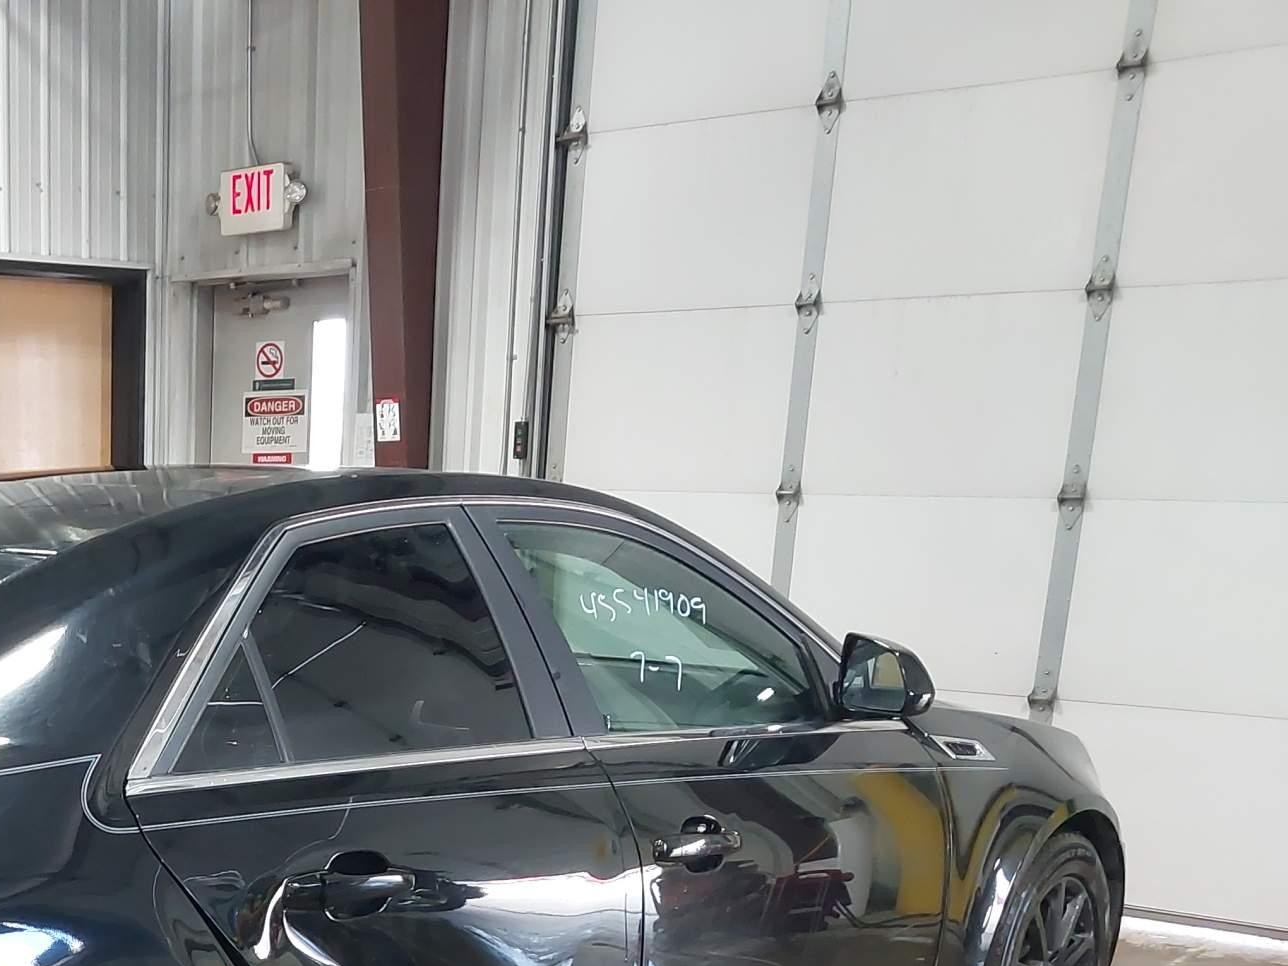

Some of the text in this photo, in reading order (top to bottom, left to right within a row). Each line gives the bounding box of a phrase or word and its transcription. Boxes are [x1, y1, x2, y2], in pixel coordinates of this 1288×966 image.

[231, 168, 274, 216] EXIT
[253, 400, 296, 412] DANGER
[249, 416, 299, 426] WATCH OUT FOR
[262, 426, 286, 435] MOVING
[256, 436, 291, 445] EQUIPMENT
[579, 587, 707, 625] 45541909
[629, 650, 683, 692] 7-7
